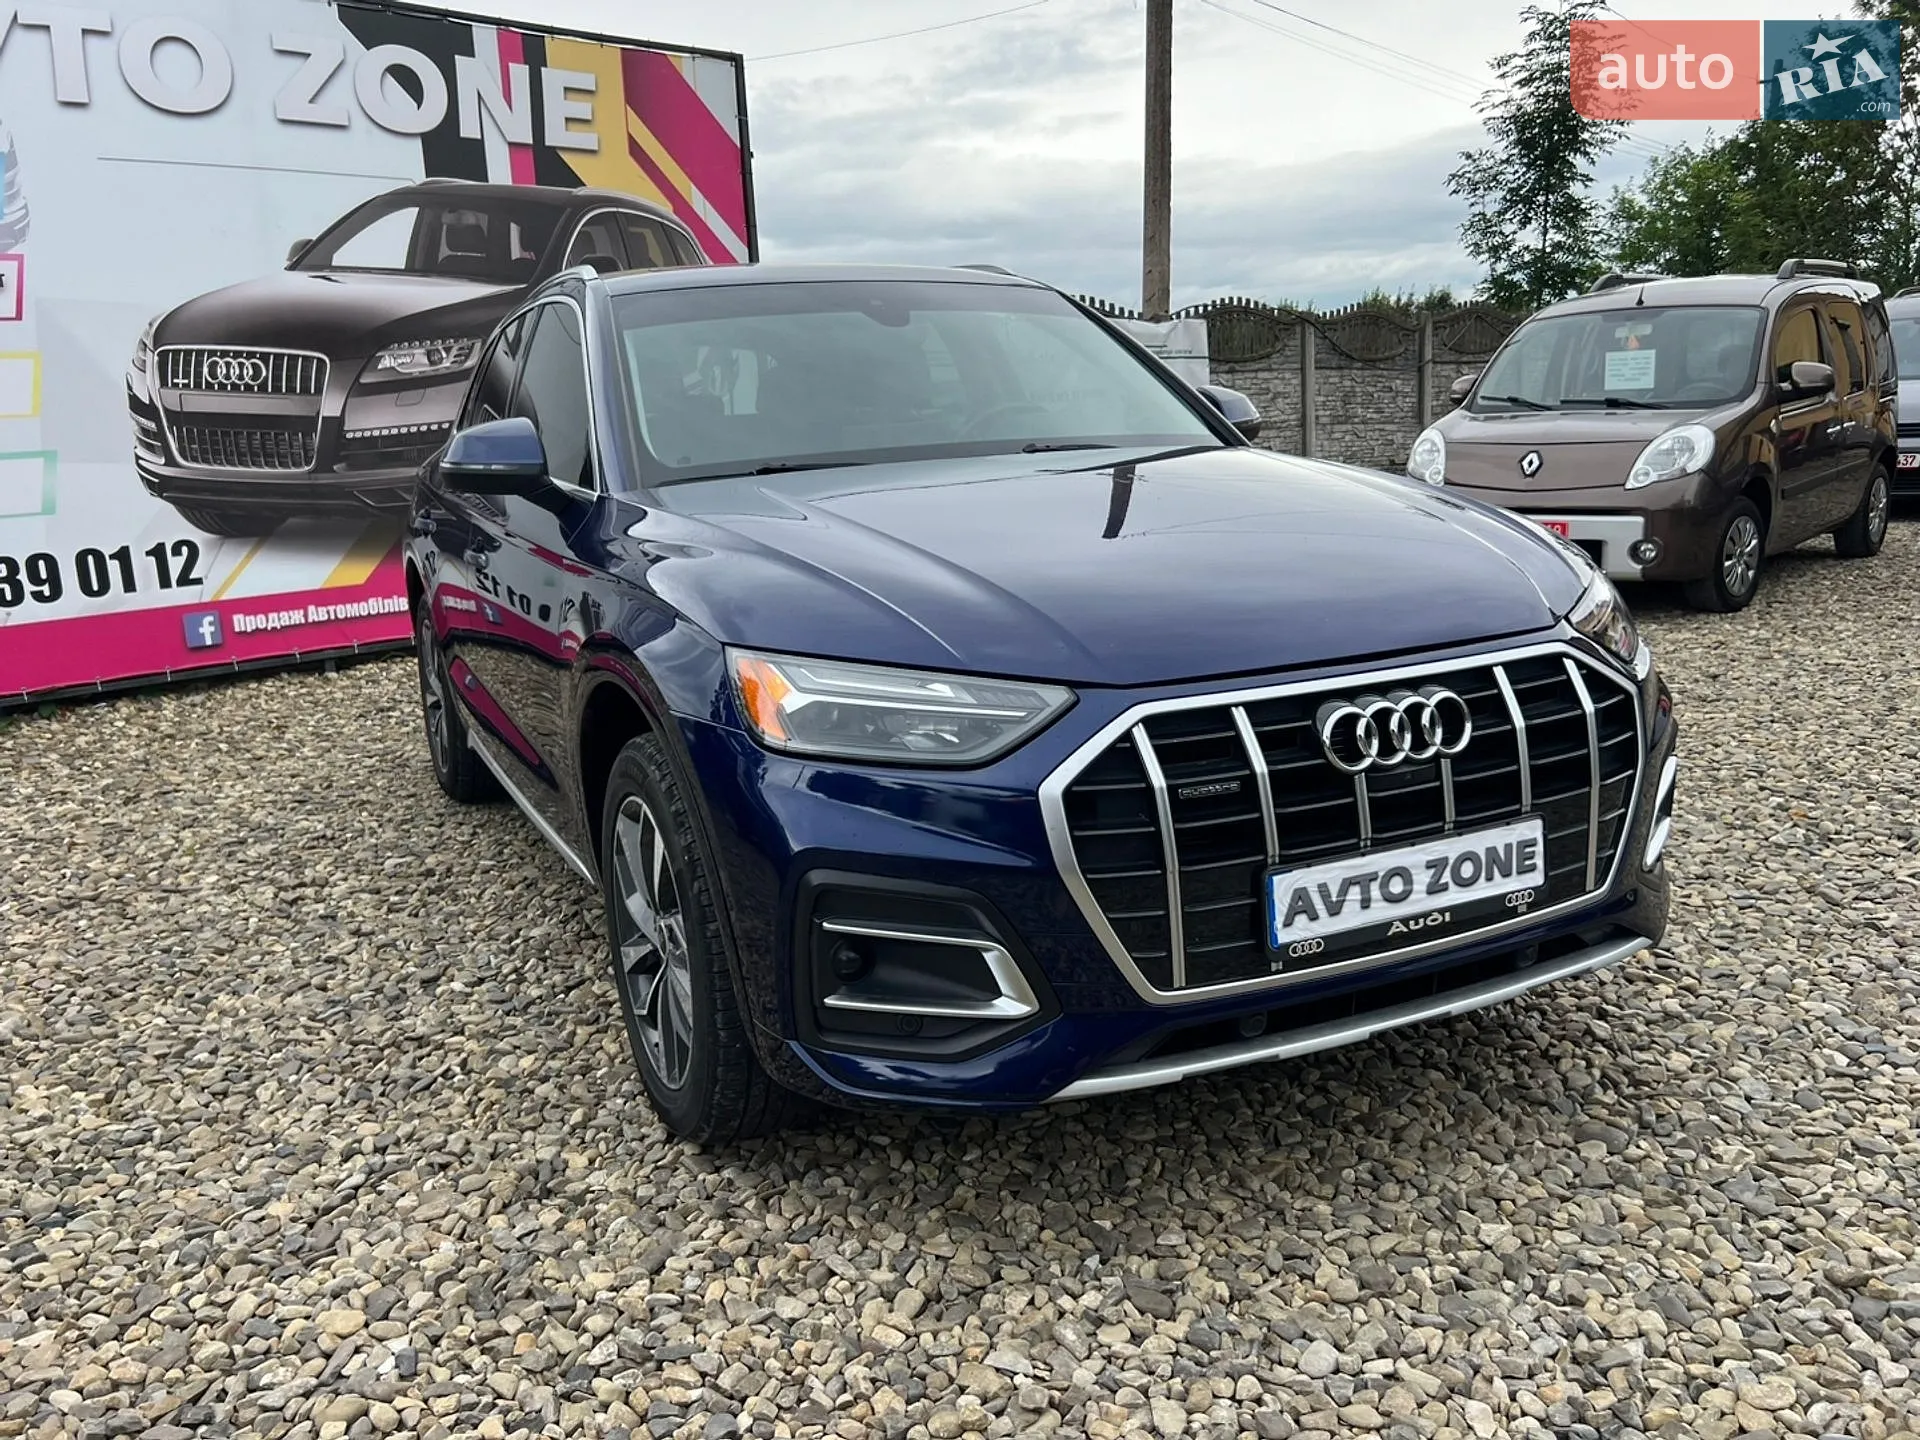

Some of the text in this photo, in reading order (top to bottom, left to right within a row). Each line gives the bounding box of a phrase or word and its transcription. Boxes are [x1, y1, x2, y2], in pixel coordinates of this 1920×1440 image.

[271, 33, 599, 151] ZONE
[75, 545, 137, 598] 01
[145, 539, 204, 590] 12
[232, 595, 409, 632] Продаж Автомобілів
[1282, 837, 1538, 927] AVTO ZONE
[1386, 911, 1450, 936] Audi
